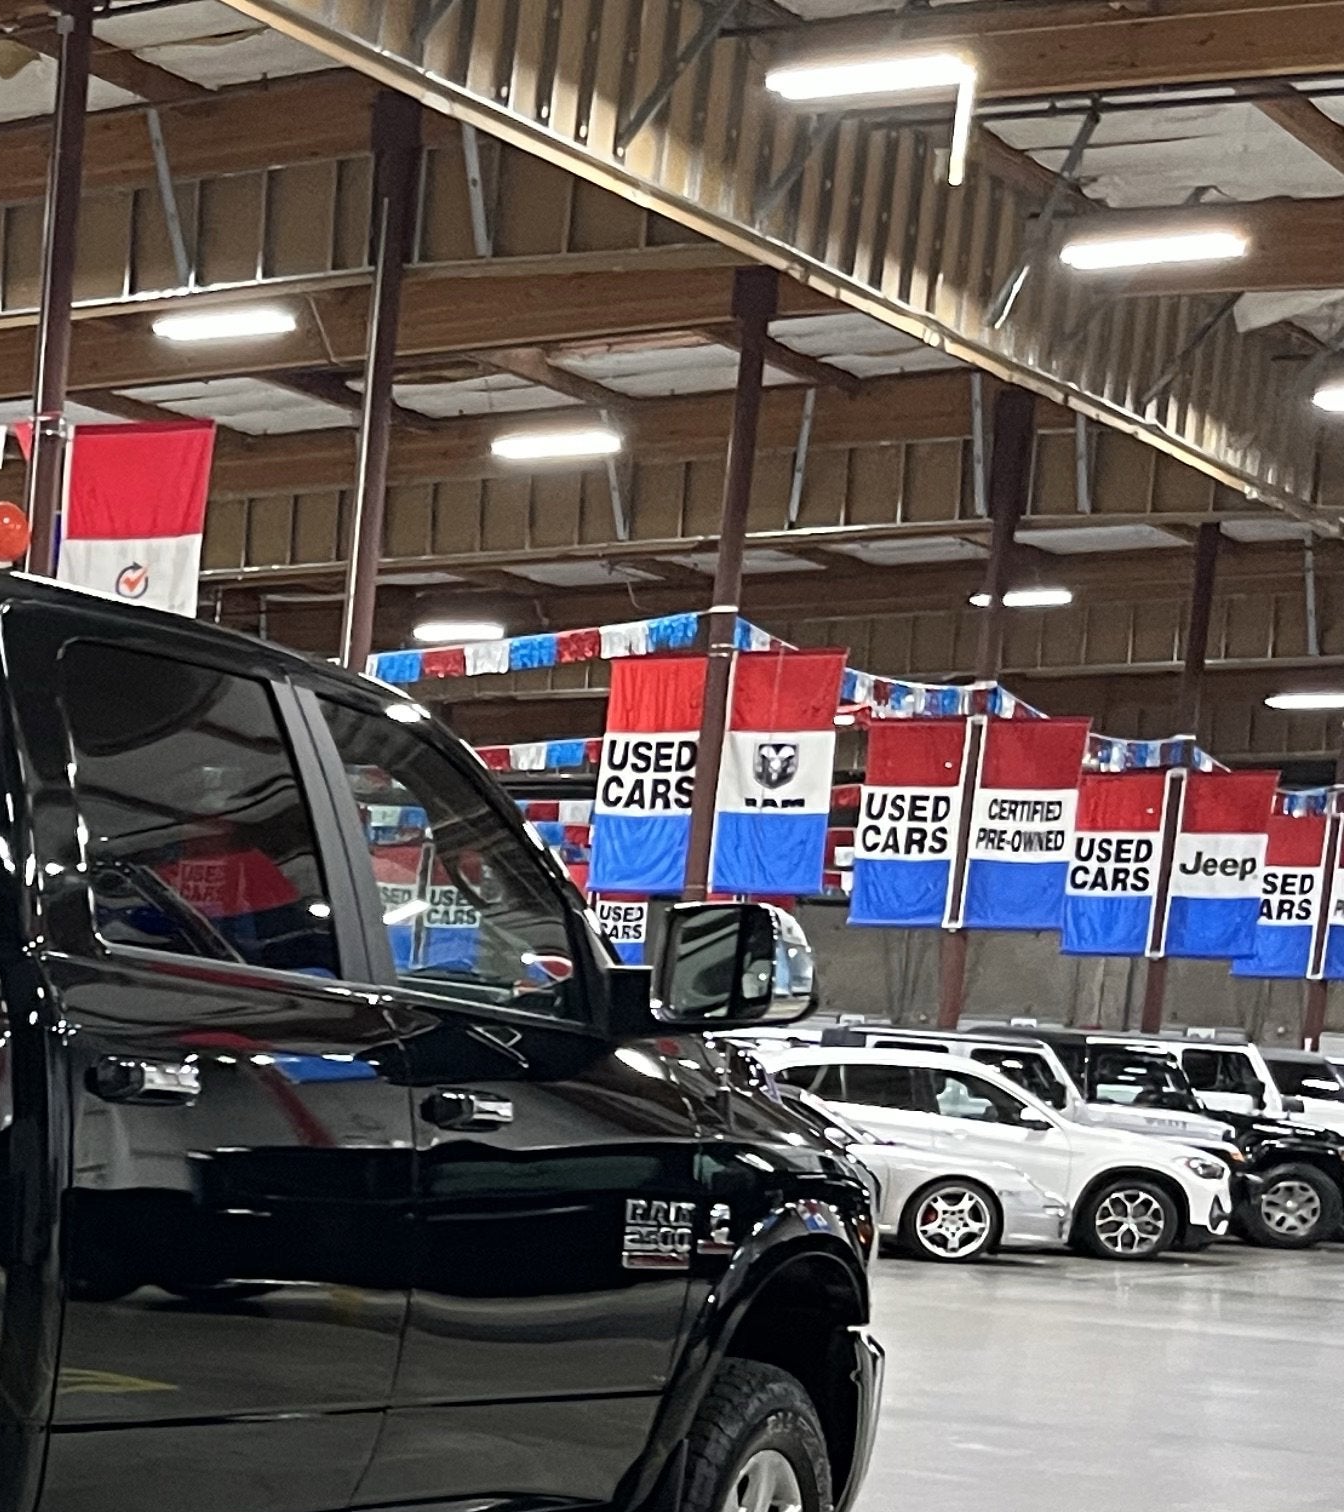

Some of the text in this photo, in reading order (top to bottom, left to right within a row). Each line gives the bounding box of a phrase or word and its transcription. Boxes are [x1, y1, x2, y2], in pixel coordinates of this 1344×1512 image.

[607, 740, 698, 773] USED
[602, 775, 694, 809] CARS
[865, 793, 951, 823] USED
[988, 798, 1062, 822] CERTIFIED
[862, 825, 948, 855] CARS
[975, 828, 1065, 852] PRE-OWNED
[1075, 837, 1153, 864] USED
[1070, 865, 1150, 892] CARS
[1179, 851, 1257, 881] Jeep
[381, 887, 411, 904] SED
[1262, 873, 1314, 895] SED
[427, 908, 477, 925] CARS
[600, 905, 644, 922] USED
[1259, 899, 1312, 920] ARS
